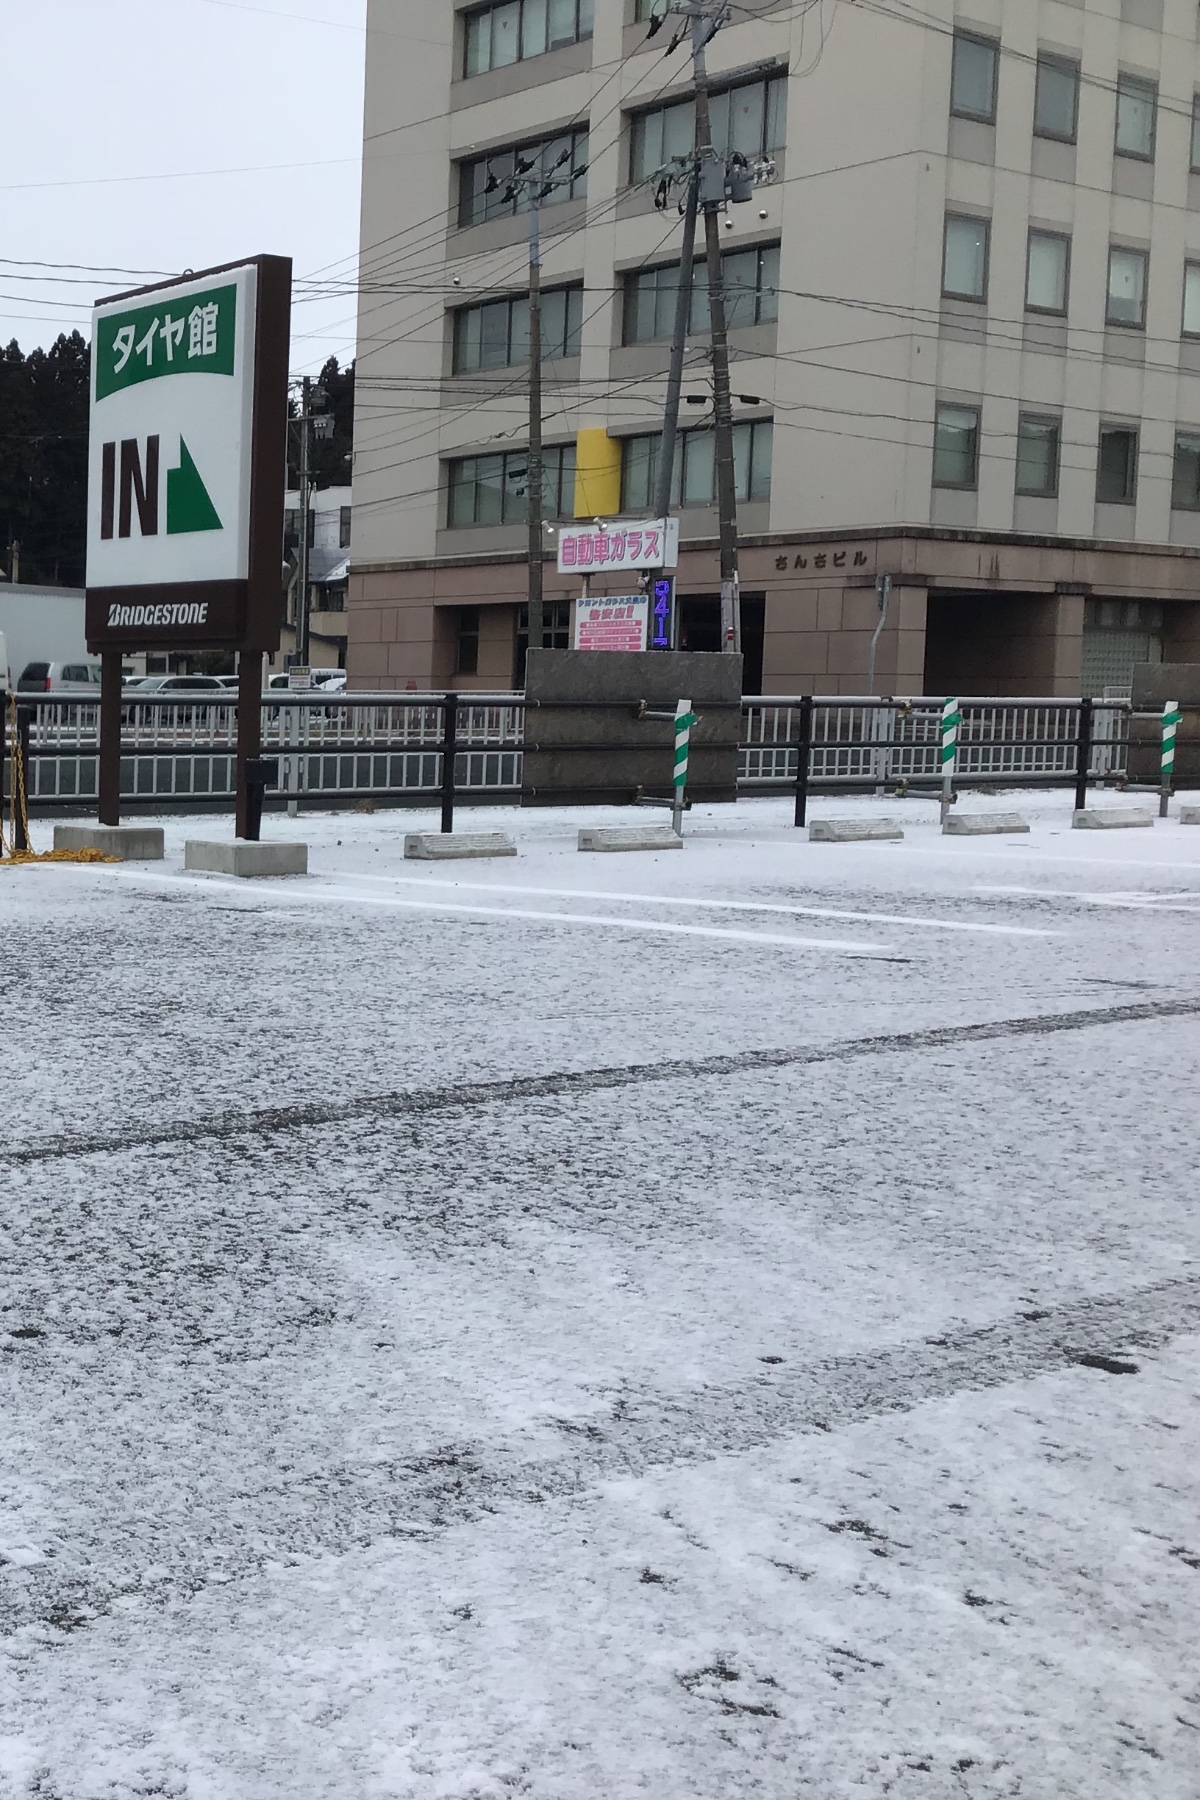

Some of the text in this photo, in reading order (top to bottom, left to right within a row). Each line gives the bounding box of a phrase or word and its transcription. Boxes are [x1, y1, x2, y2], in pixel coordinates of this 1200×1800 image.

[111, 302, 219, 373] タイヤ館
[101, 434, 160, 540] IN
[561, 530, 660, 566] 自動車ガラス
[774, 551, 868, 571] さんさビル
[108, 602, 208, 627] BRIDGESTONE
